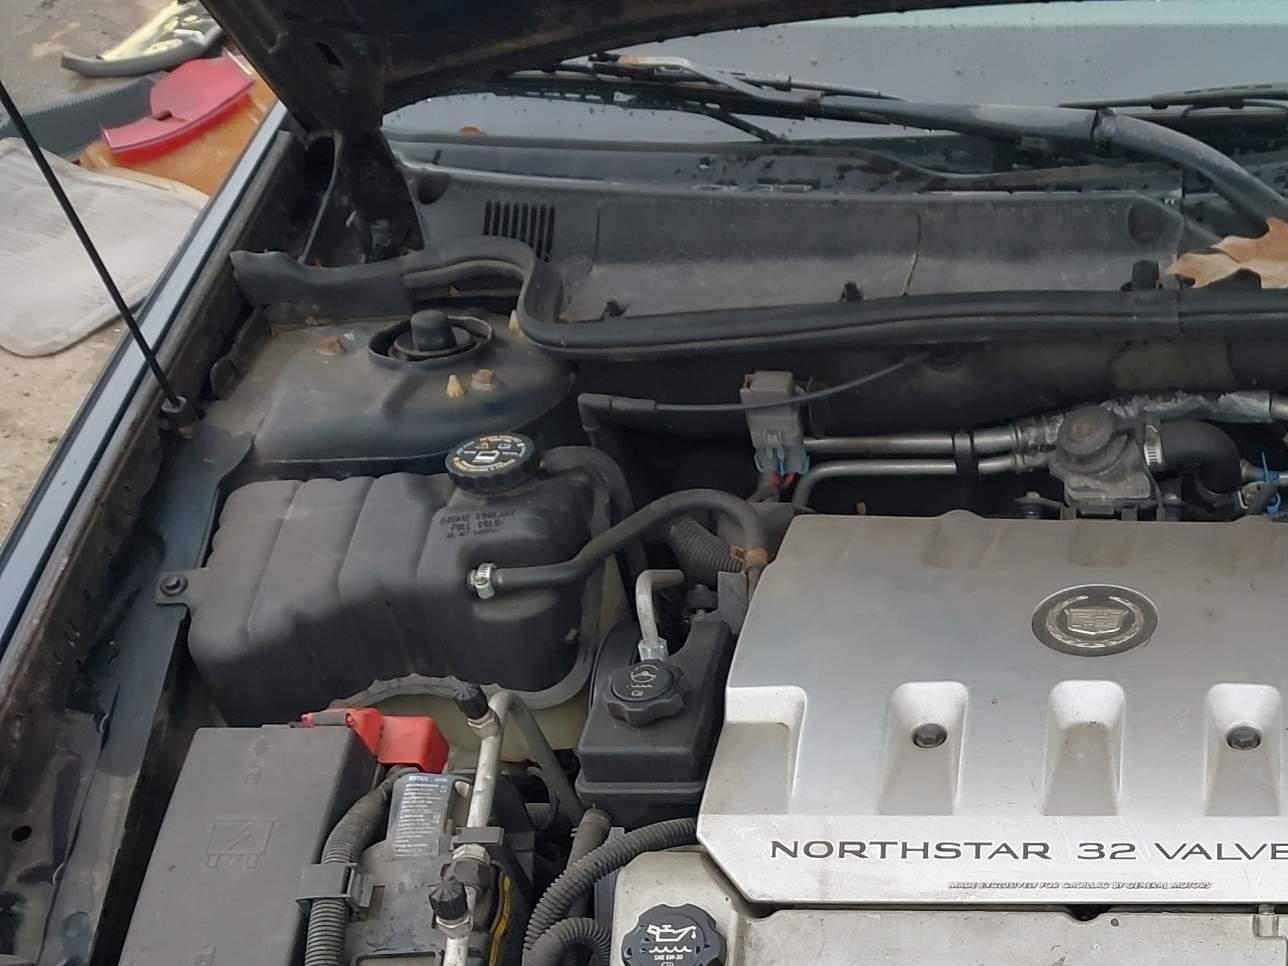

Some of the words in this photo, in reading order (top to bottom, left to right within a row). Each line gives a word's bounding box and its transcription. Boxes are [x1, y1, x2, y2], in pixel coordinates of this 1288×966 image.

[770, 841, 1053, 860] NORTHSTAR
[1076, 842, 1137, 860] 32
[1126, 880, 1168, 890] GENERAL
[1169, 880, 1211, 890] MOTORS
